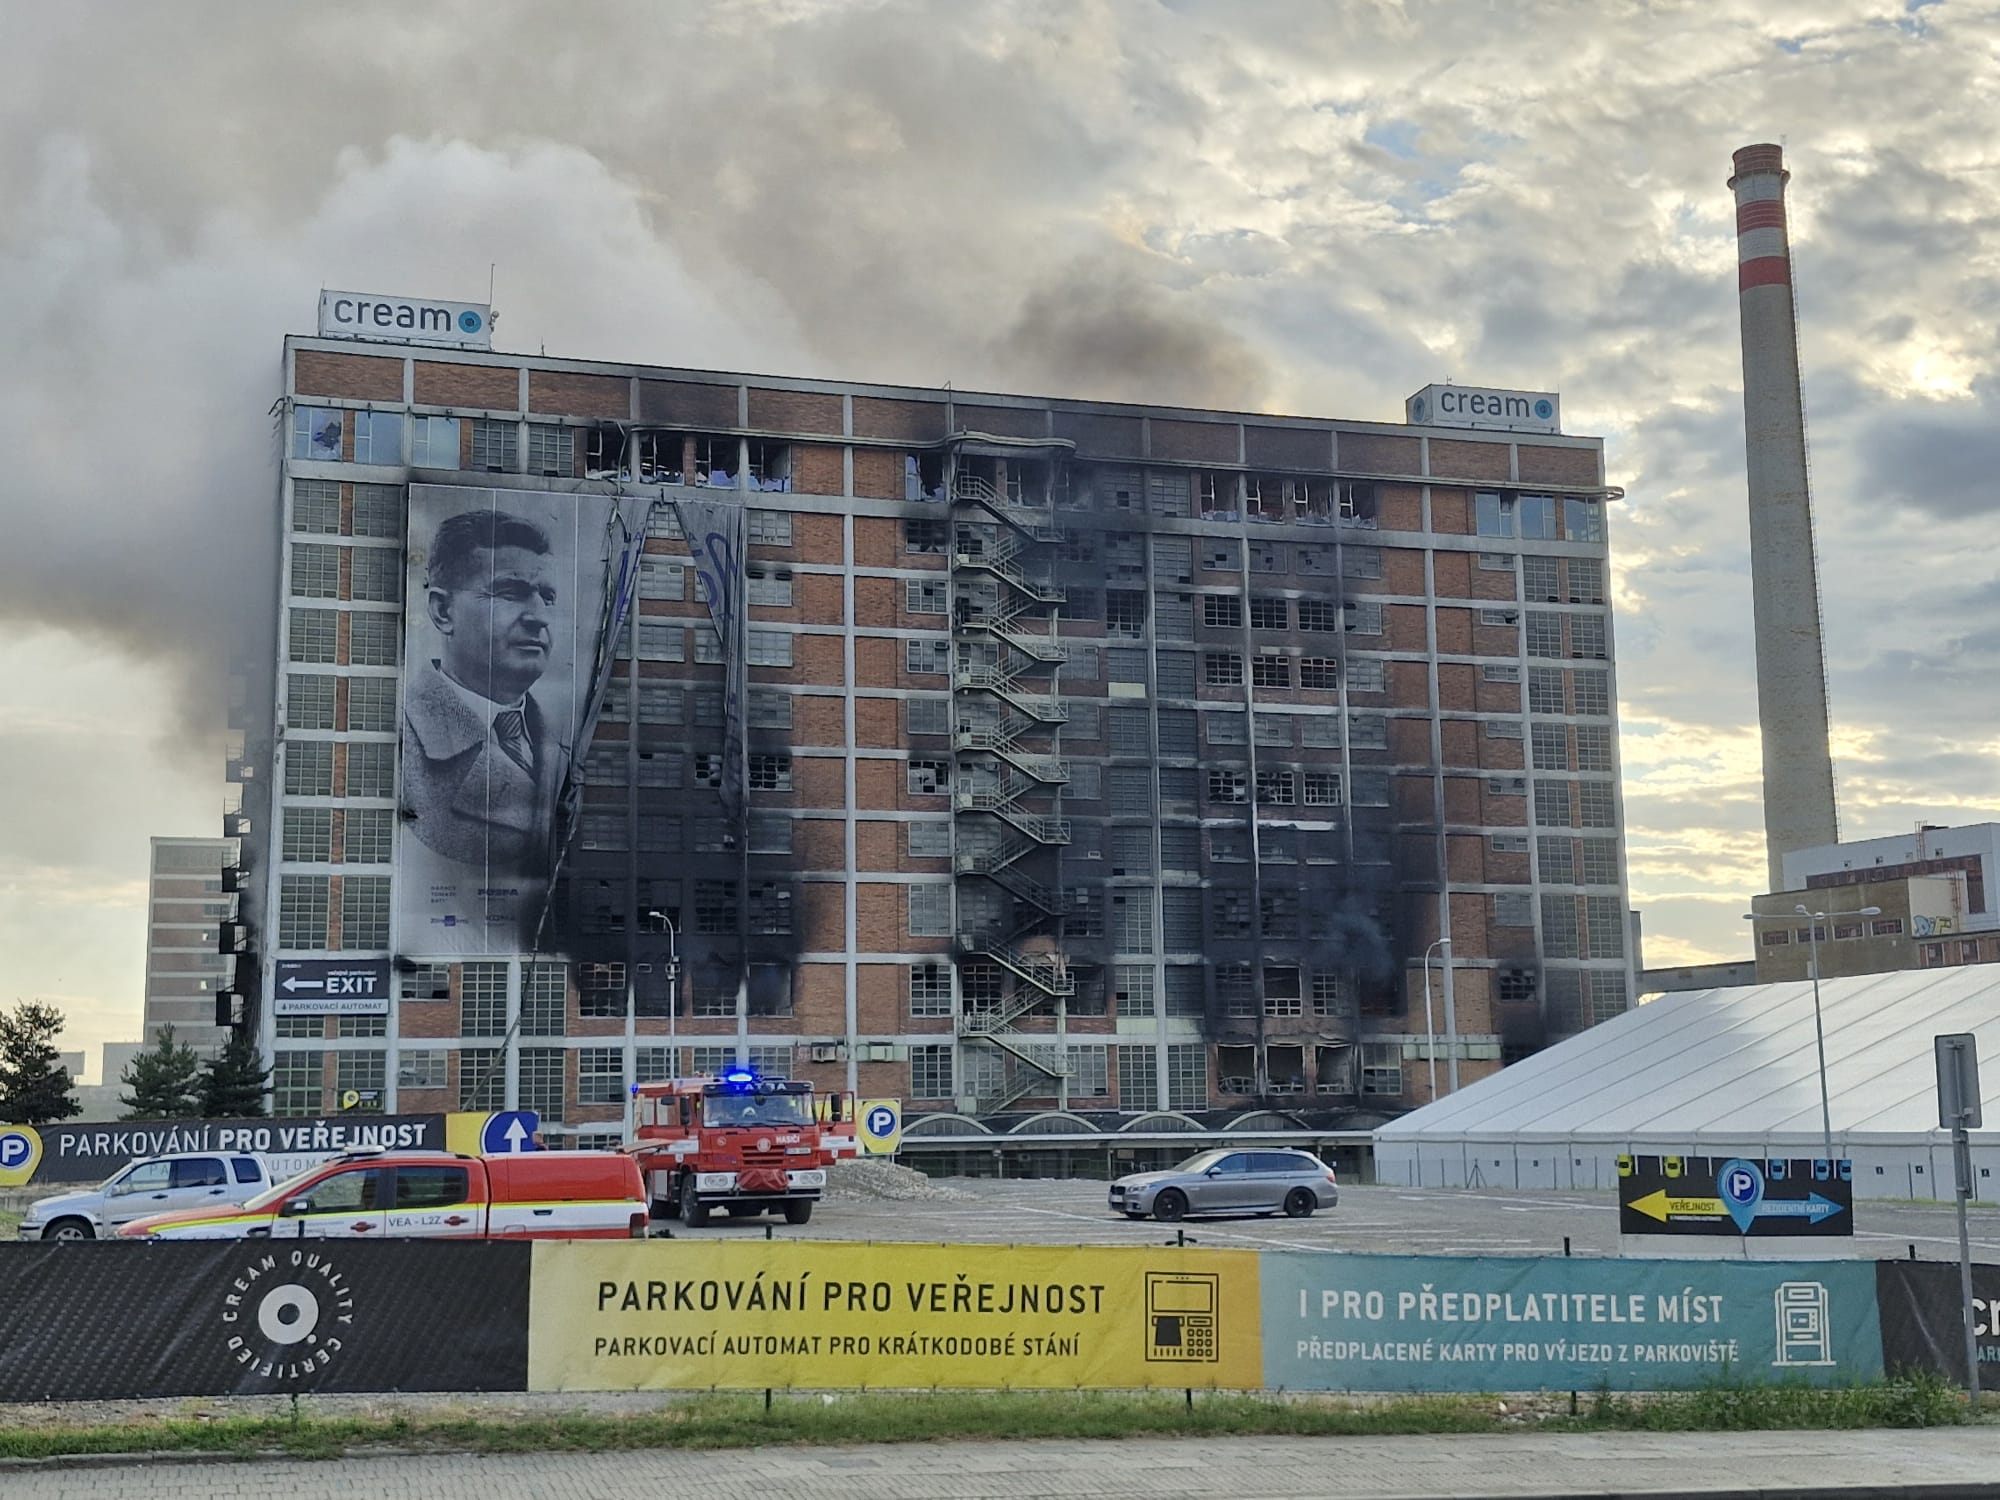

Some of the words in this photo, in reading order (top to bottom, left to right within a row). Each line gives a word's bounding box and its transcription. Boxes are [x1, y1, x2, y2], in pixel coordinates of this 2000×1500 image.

[334, 299, 451, 332] cream
[1441, 391, 1530, 418] cream
[326, 977, 377, 994] EXIT
[288, 1001, 339, 1011] PARKOVACÍ
[341, 1002, 383, 1010] AUTOMAT
[873, 1112, 892, 1133] P
[2, 1139, 25, 1163] P
[60, 1124, 212, 1157] PARKOVÁNÍ
[219, 1128, 271, 1150] PRO
[278, 1120, 427, 1150] VEŘEJNOST
[1733, 1174, 1751, 1197] P
[1669, 1200, 1716, 1212] VEŘEJNOST
[388, 1217, 412, 1227] VEA
[222, 1255, 277, 1322] CREAM
[291, 1250, 353, 1324] QUALITY
[598, 1271, 811, 1311] PARKOVÁNÍ
[824, 1281, 890, 1312] PRO
[907, 1274, 1105, 1314] VEŘEJNOST
[1322, 1290, 1384, 1320] PRO
[1398, 1283, 1645, 1322] PŘEDPLATITELE
[1658, 1286, 1723, 1323] MÍST
[595, 1330, 719, 1356] PARKOVACÍ
[723, 1336, 821, 1355] AUTOMAT
[829, 1337, 870, 1356] PRO
[878, 1331, 1015, 1356] KRÁTKODOBÉ
[1023, 1332, 1080, 1356] STÁNÍ
[1297, 1335, 1433, 1361] PŘEDPLACENÉ
[1439, 1344, 1497, 1361] KARTY
[1503, 1344, 1539, 1361] PRO
[1544, 1338, 1612, 1362] VÝJEZD
[1618, 1344, 1628, 1363] Z
[1634, 1339, 1739, 1363] PARKOVIŠTĚ
[227, 1336, 342, 1379] CERTIFIED
